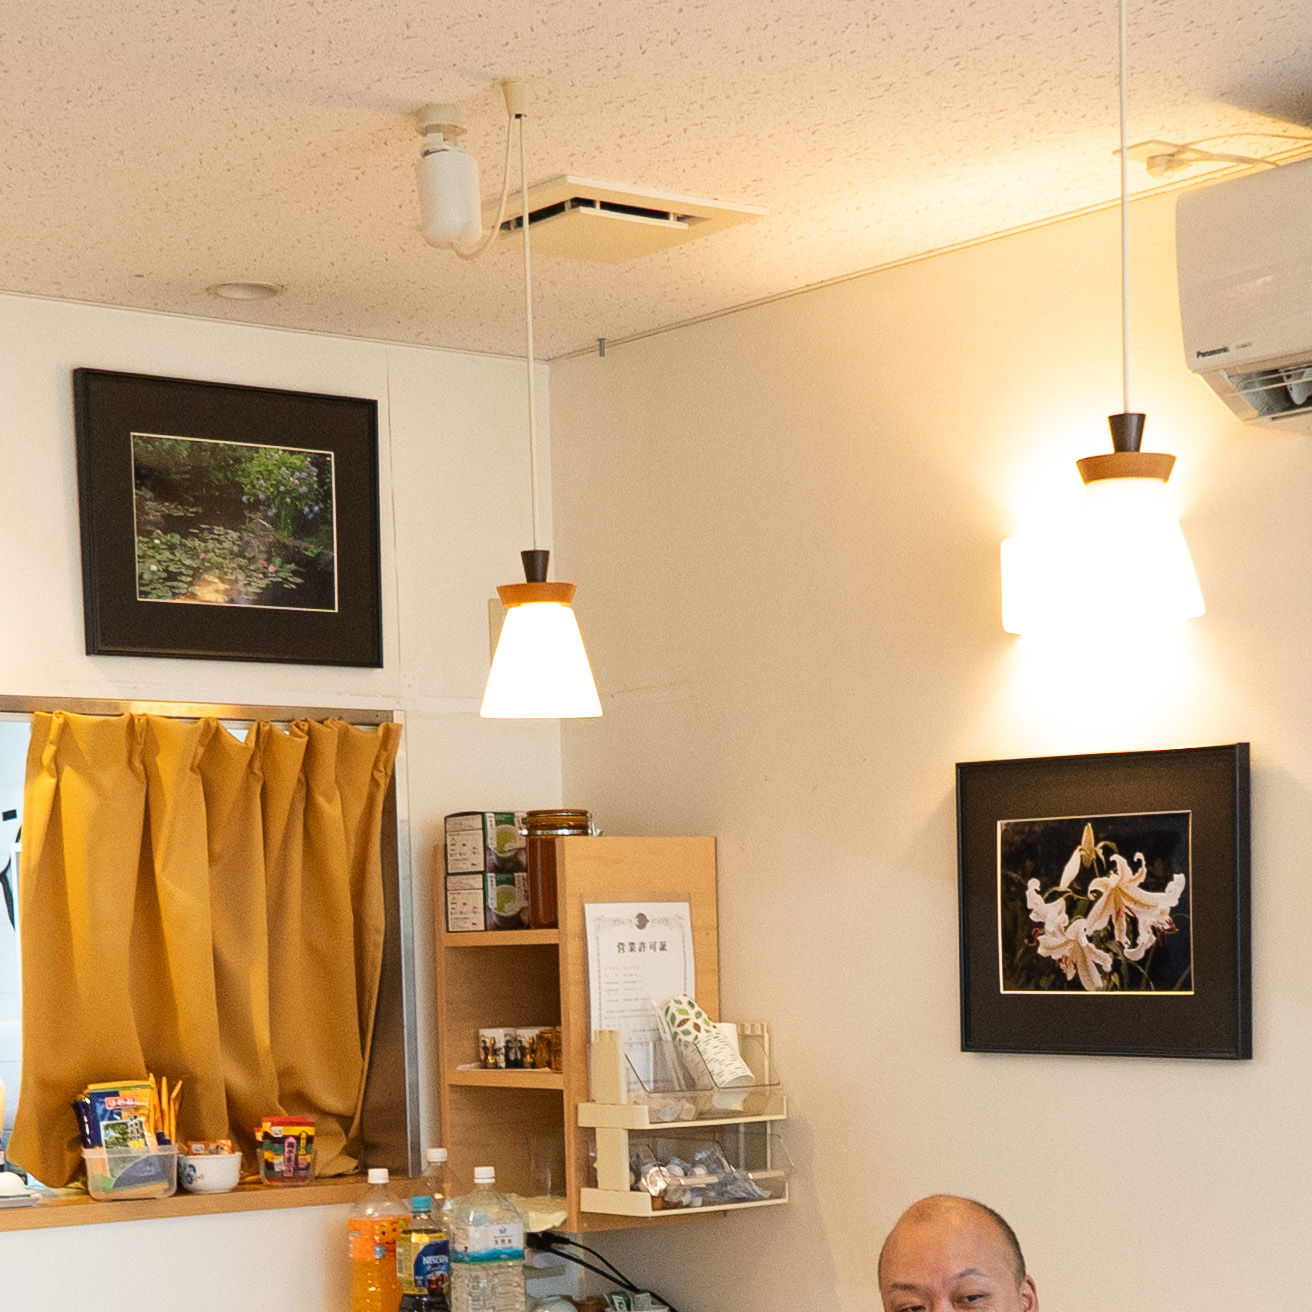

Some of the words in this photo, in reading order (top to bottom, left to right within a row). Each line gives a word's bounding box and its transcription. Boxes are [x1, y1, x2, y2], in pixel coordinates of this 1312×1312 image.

[617, 941, 668, 954] 営業許可証
